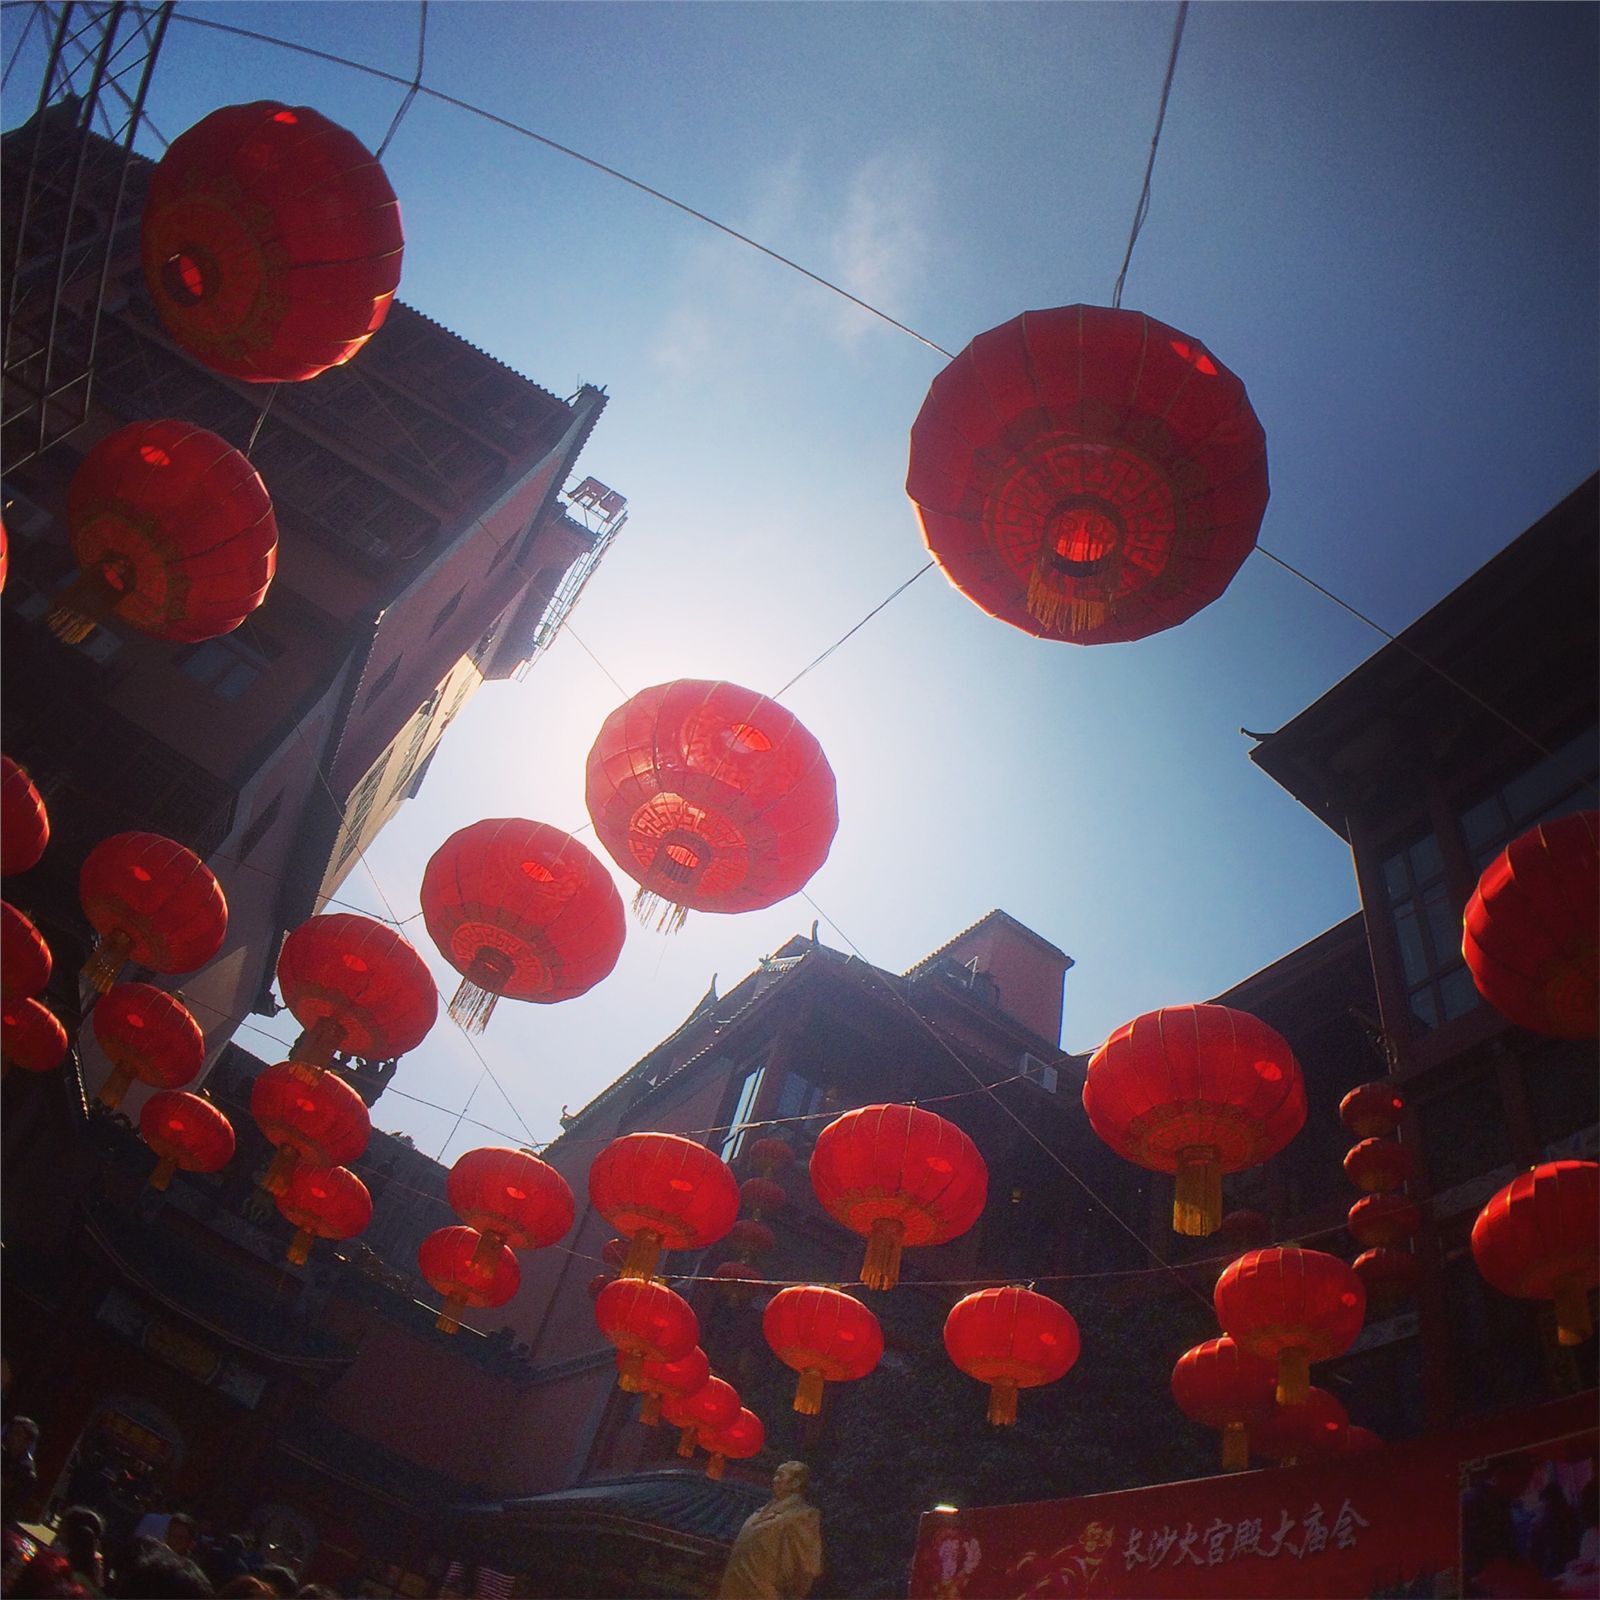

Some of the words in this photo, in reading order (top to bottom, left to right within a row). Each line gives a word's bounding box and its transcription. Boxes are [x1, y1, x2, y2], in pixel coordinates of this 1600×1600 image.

[1122, 1497, 1370, 1571] 长沙火宫殿大庙会
